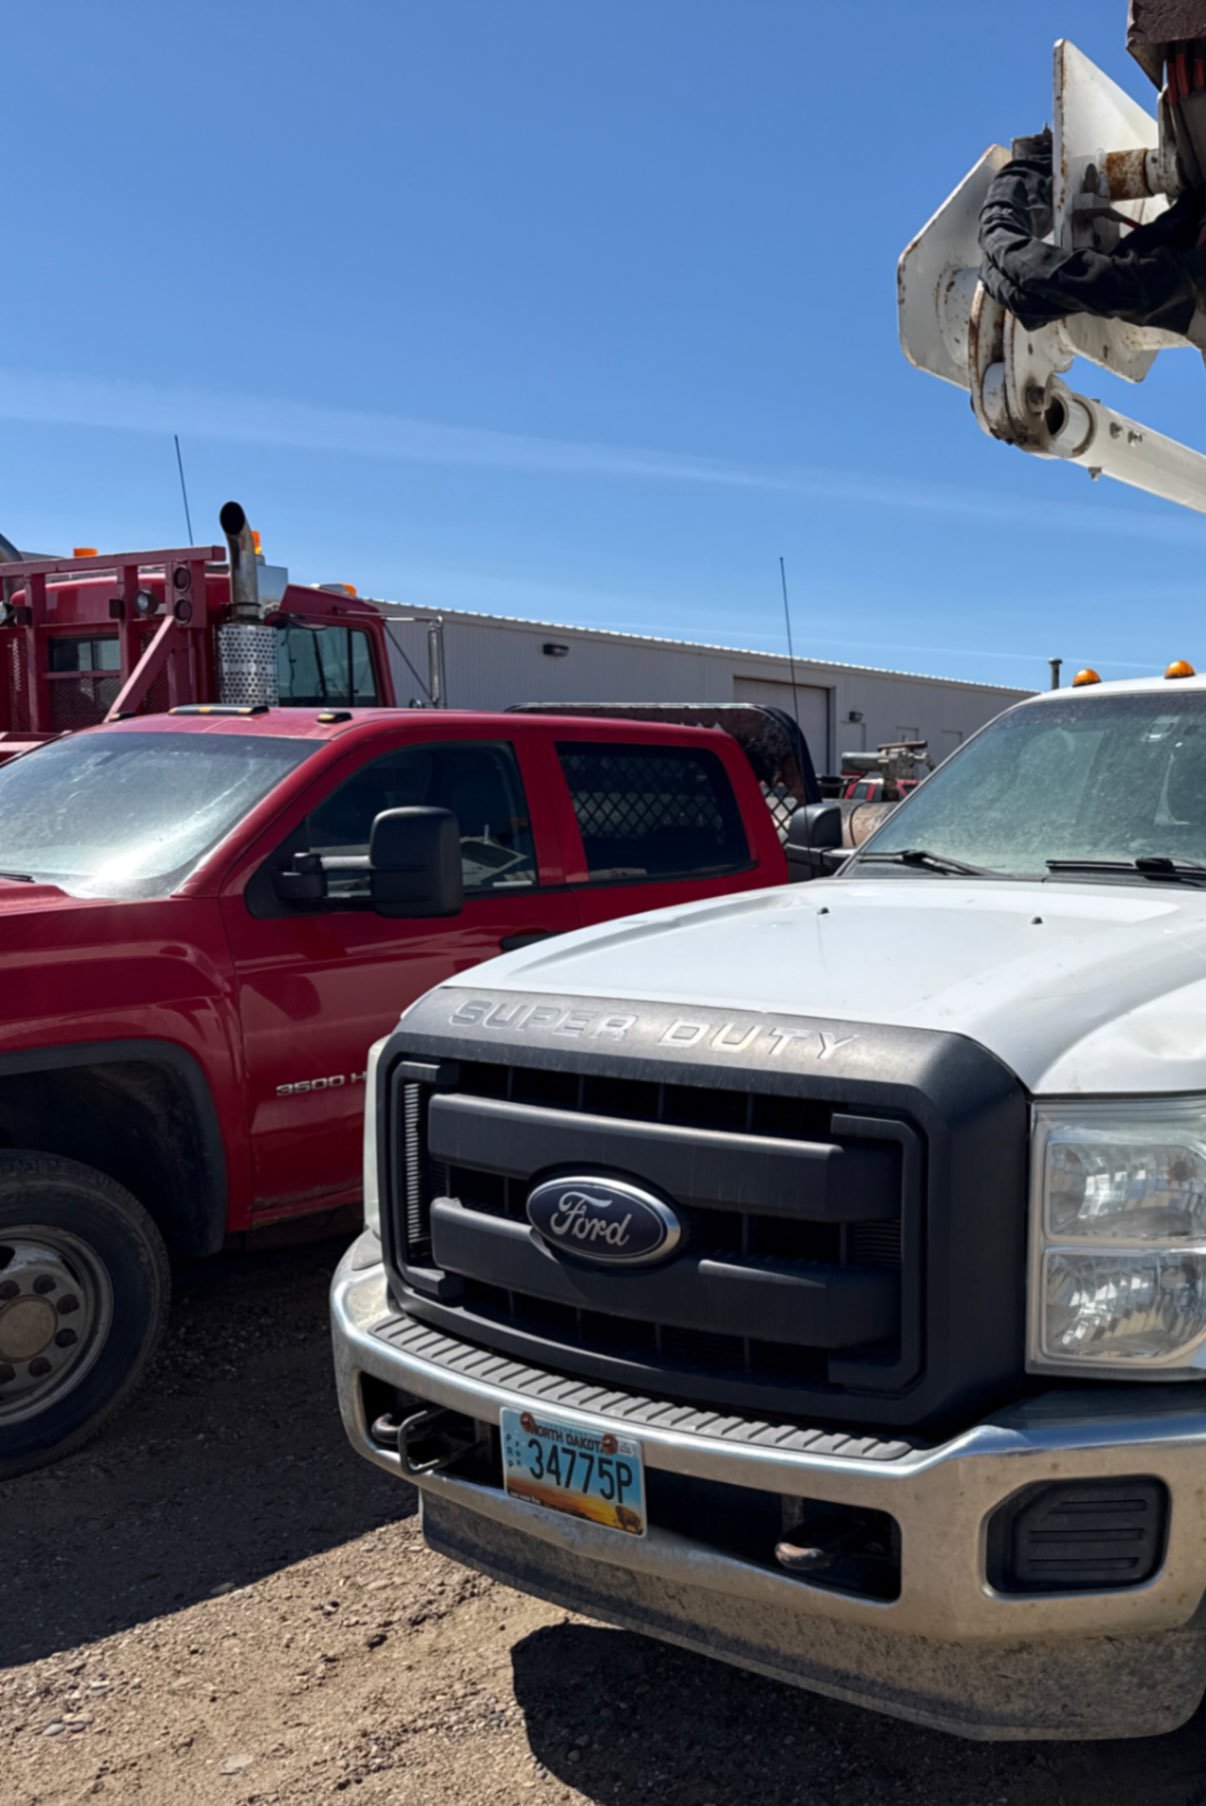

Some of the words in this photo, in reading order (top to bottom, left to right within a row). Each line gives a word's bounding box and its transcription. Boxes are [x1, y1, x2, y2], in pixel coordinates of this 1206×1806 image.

[449, 1000, 639, 1043] SUPER
[656, 1017, 862, 1060] DUTY
[275, 1074, 345, 1097] 3500
[550, 1190, 633, 1247] Ford
[528, 1438, 633, 1504] 34775P
